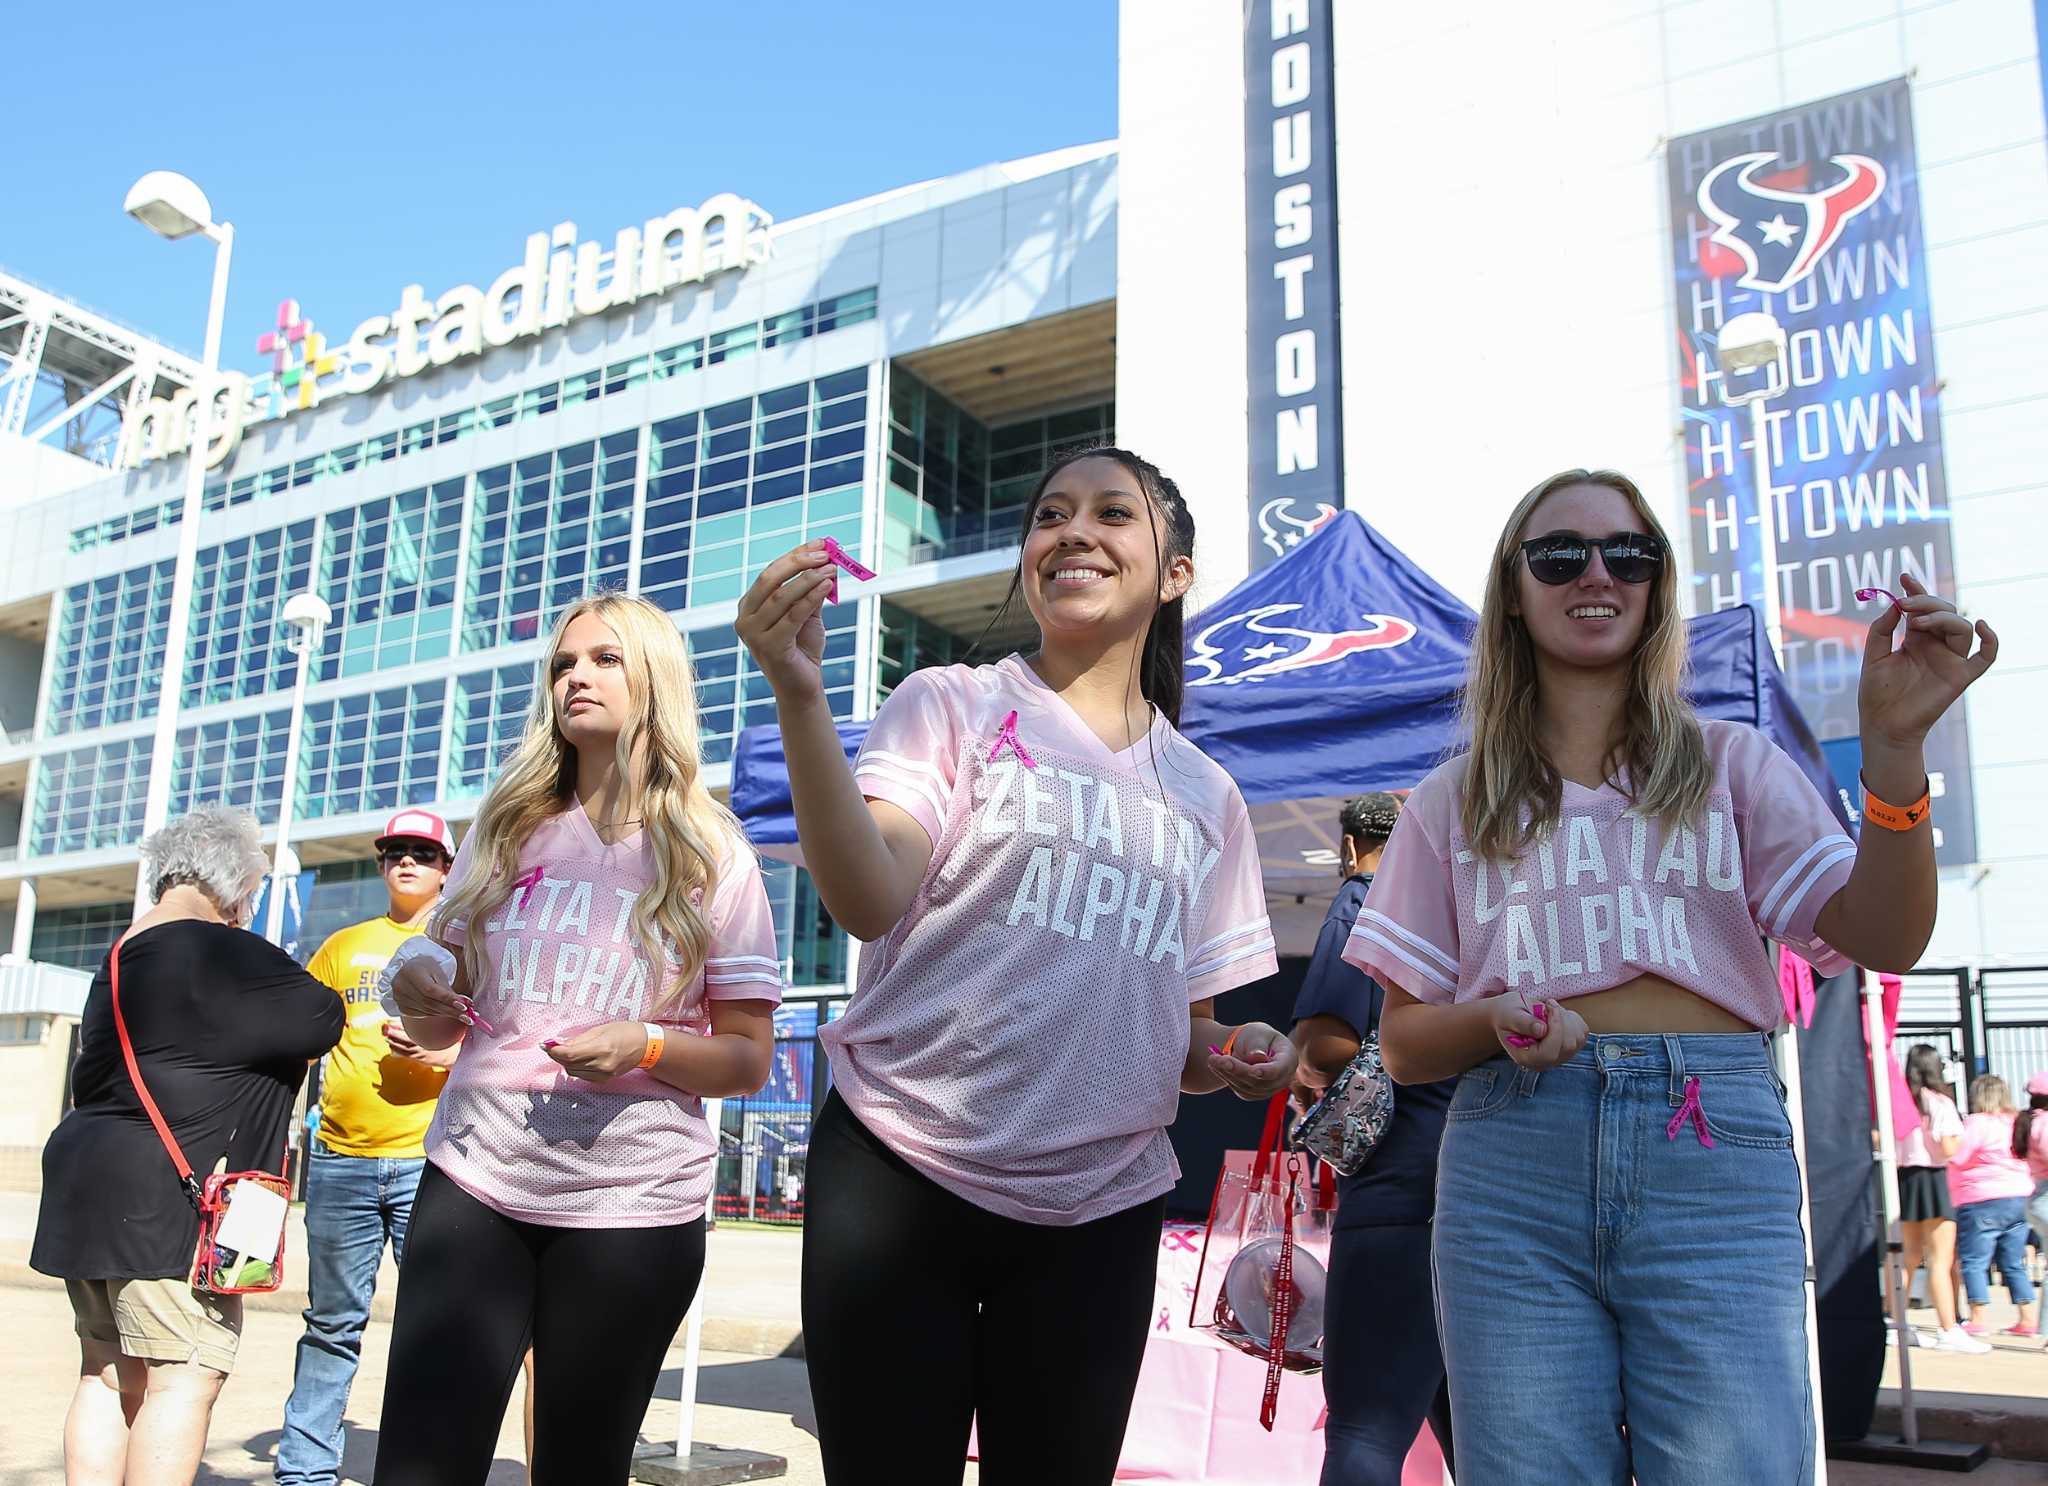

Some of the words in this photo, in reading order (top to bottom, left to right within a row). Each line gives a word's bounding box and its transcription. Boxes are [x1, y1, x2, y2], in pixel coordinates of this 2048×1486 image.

[1271, 0, 1319, 476] HOUSTON
[341, 193, 757, 394] stadium
[1701, 385, 1925, 480] H-TOWN
[1705, 463, 1932, 554] H-TOWN
[975, 761, 1124, 857] ZETA
[1621, 809, 1742, 892] TAU
[487, 877, 593, 936] ETA
[1006, 846, 1185, 974] ALPHA
[1506, 885, 1701, 987] ALPHA
[499, 938, 649, 1022] ALPHA
